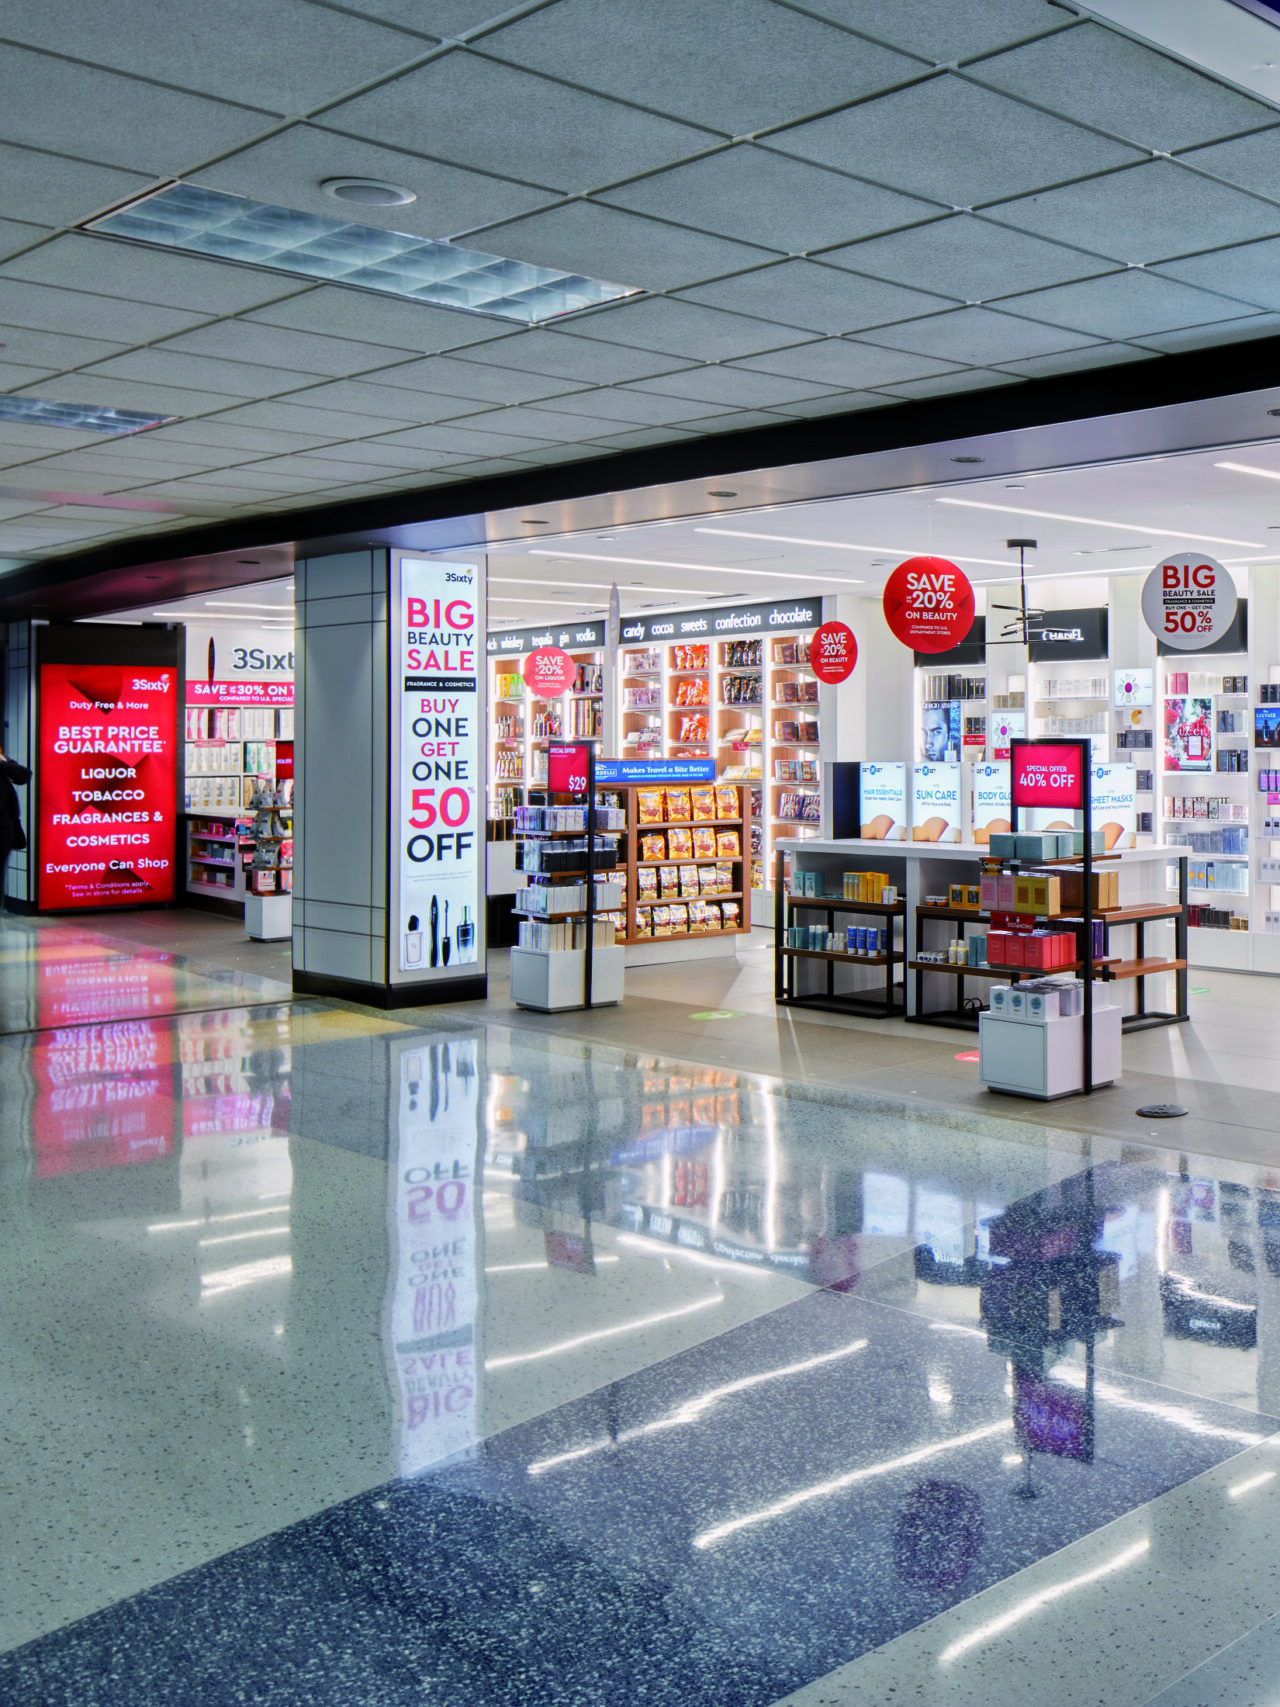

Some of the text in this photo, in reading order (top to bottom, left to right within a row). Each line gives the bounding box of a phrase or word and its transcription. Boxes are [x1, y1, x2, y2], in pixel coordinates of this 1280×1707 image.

[445, 572, 473, 585] 3Sixty
[906, 572, 956, 592] SAVE
[1163, 564, 1215, 589] BIG
[912, 590, 954, 609] 20%
[1196, 589, 1215, 597] SALE
[407, 597, 474, 630] BIG
[769, 607, 813, 626] chocolate
[905, 611, 958, 621] ON BEAUTY
[715, 613, 762, 630] confection
[623, 618, 707, 640] candy cocoa sweets
[1196, 625, 1214, 633] OFF
[407, 631, 474, 646] BEAUTY
[820, 632, 847, 645] SAVE
[823, 645, 846, 656] 20%
[406, 648, 474, 671] SALE
[535, 656, 565, 666] SAVE
[538, 665, 563, 675] 20%
[132, 678, 170, 693] 3Sixty
[194, 684, 227, 694] SAVE
[237, 684, 264, 695] 30%
[267, 685, 287, 695] ON
[69, 701, 92, 710] Duty
[94, 701, 115, 709] Free
[421, 698, 459, 713] BUY
[58, 726, 159, 739] BEST PRICE
[411, 717, 469, 738] ONE
[421, 742, 459, 757] GET
[81, 768, 137, 779] LIQUOR
[411, 760, 469, 781] ONE
[646, 766, 667, 774] Travel
[689, 765, 709, 773] Better
[568, 774, 587, 792] $29
[1019, 774, 1075, 787] 40% OFF
[72, 789, 145, 802] TOBACCO
[916, 790, 957, 800] SUN CARE
[978, 791, 997, 799] BODY
[1111, 794, 1133, 803] MASKS
[52, 811, 163, 825] FRAGRANCES &
[65, 833, 150, 847] COSMETICS
[406, 831, 474, 863] OFF
[45, 857, 169, 874] Everyone Can Shop
